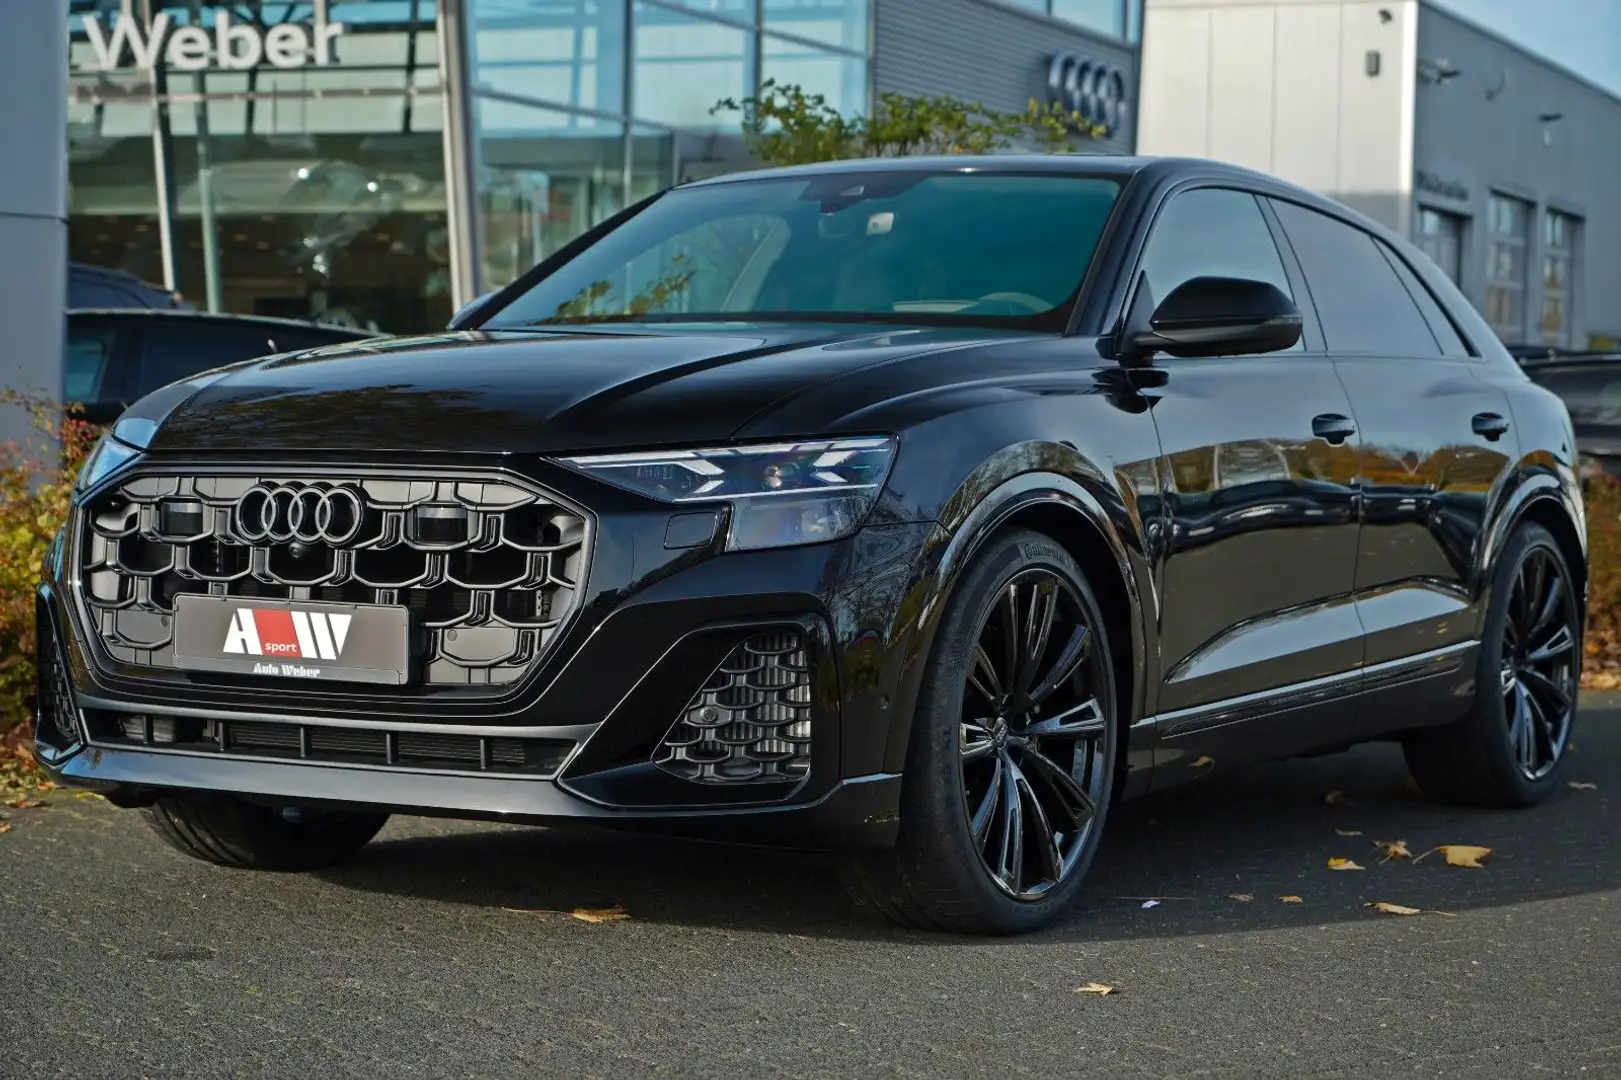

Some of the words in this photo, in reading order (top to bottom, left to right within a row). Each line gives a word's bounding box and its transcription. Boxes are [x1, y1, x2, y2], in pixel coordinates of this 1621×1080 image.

[82, 10, 344, 69] Weber
[265, 642, 297, 653] sport
[253, 662, 280, 676] Auto
[281, 664, 321, 678] Weber
